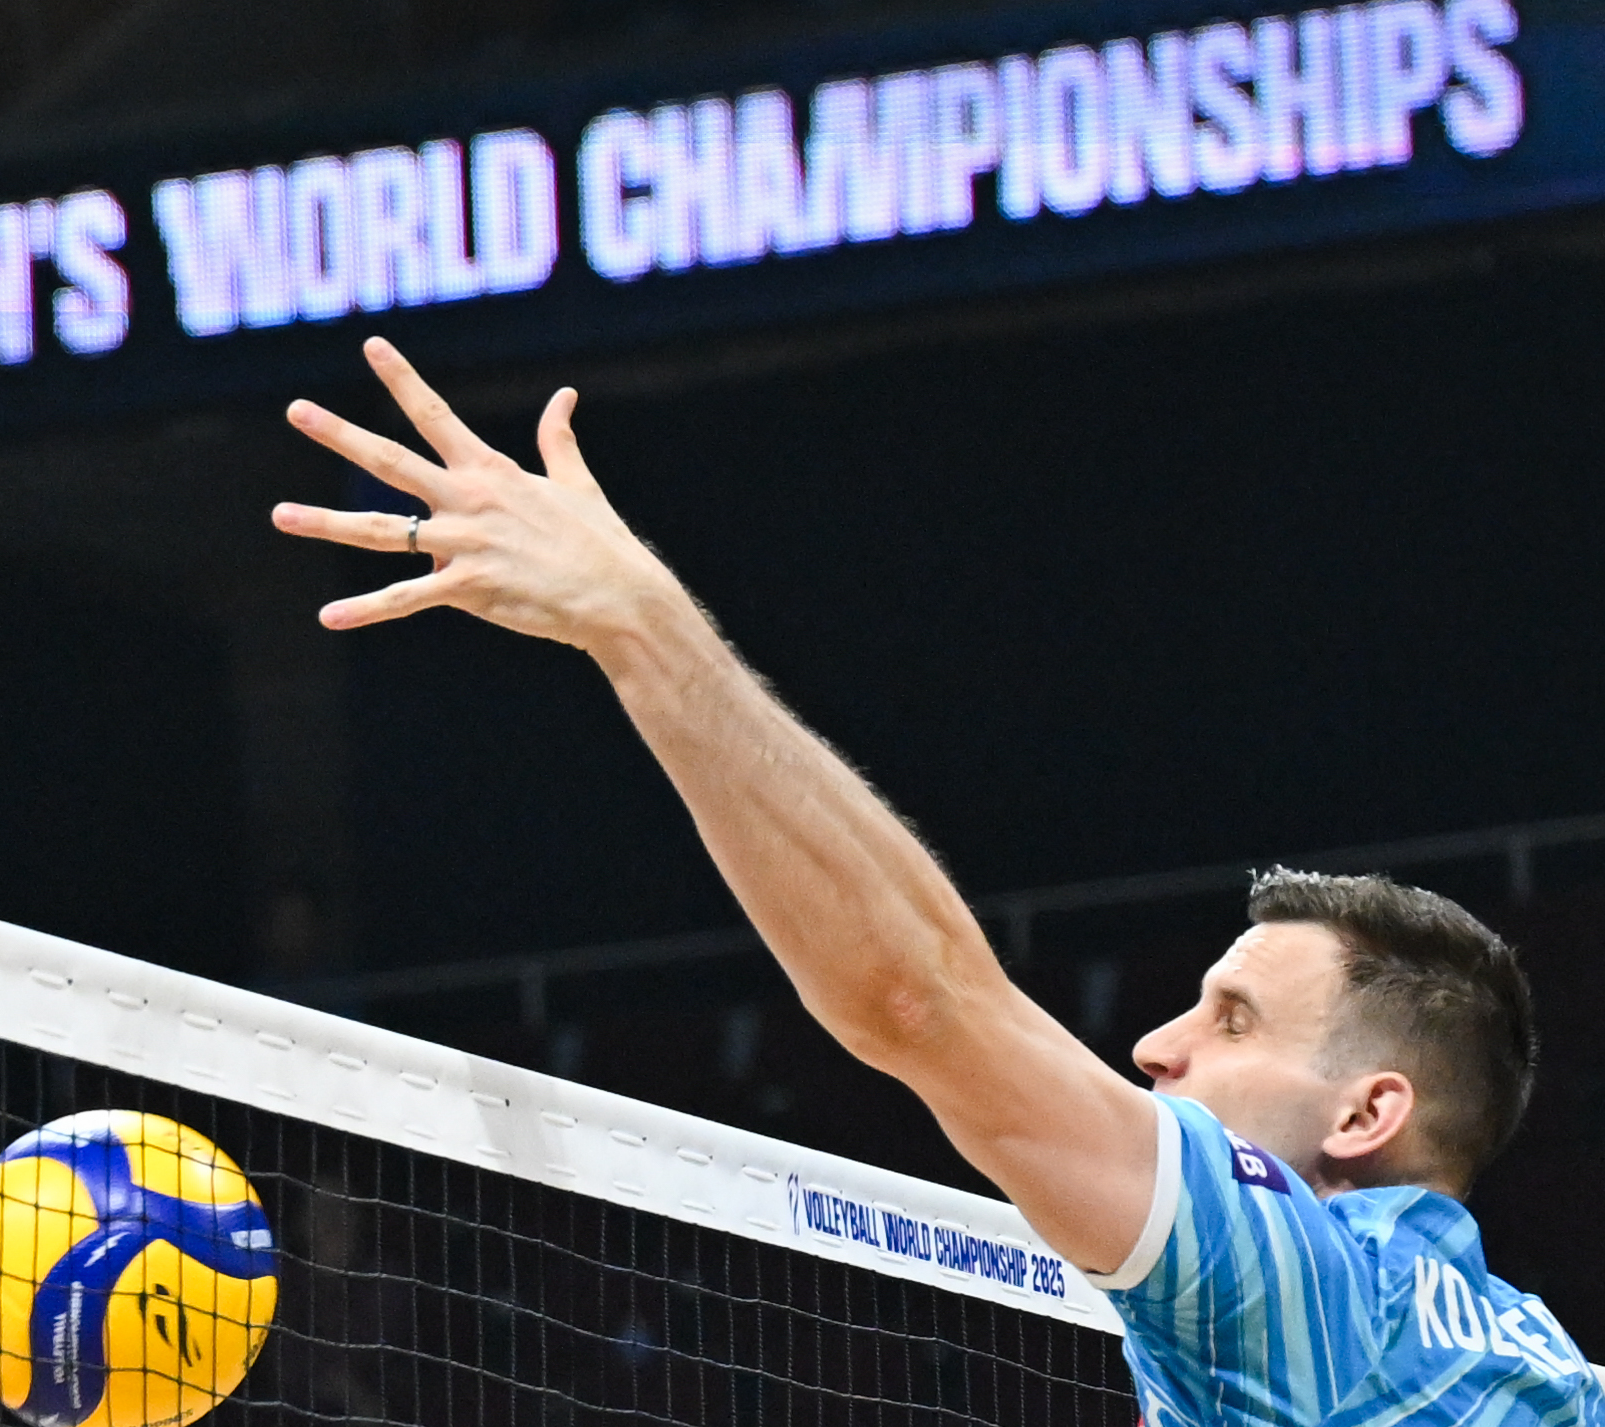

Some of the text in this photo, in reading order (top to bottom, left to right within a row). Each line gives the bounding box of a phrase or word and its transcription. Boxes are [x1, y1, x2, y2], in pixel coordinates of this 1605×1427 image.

[152, 127, 558, 337] WORLD
[580, 0, 1524, 281] CHAMPIONSHIPS
[803, 1187, 1066, 1299] VOLLEYBALL WORLD CHAMPIONSHIP 2025
